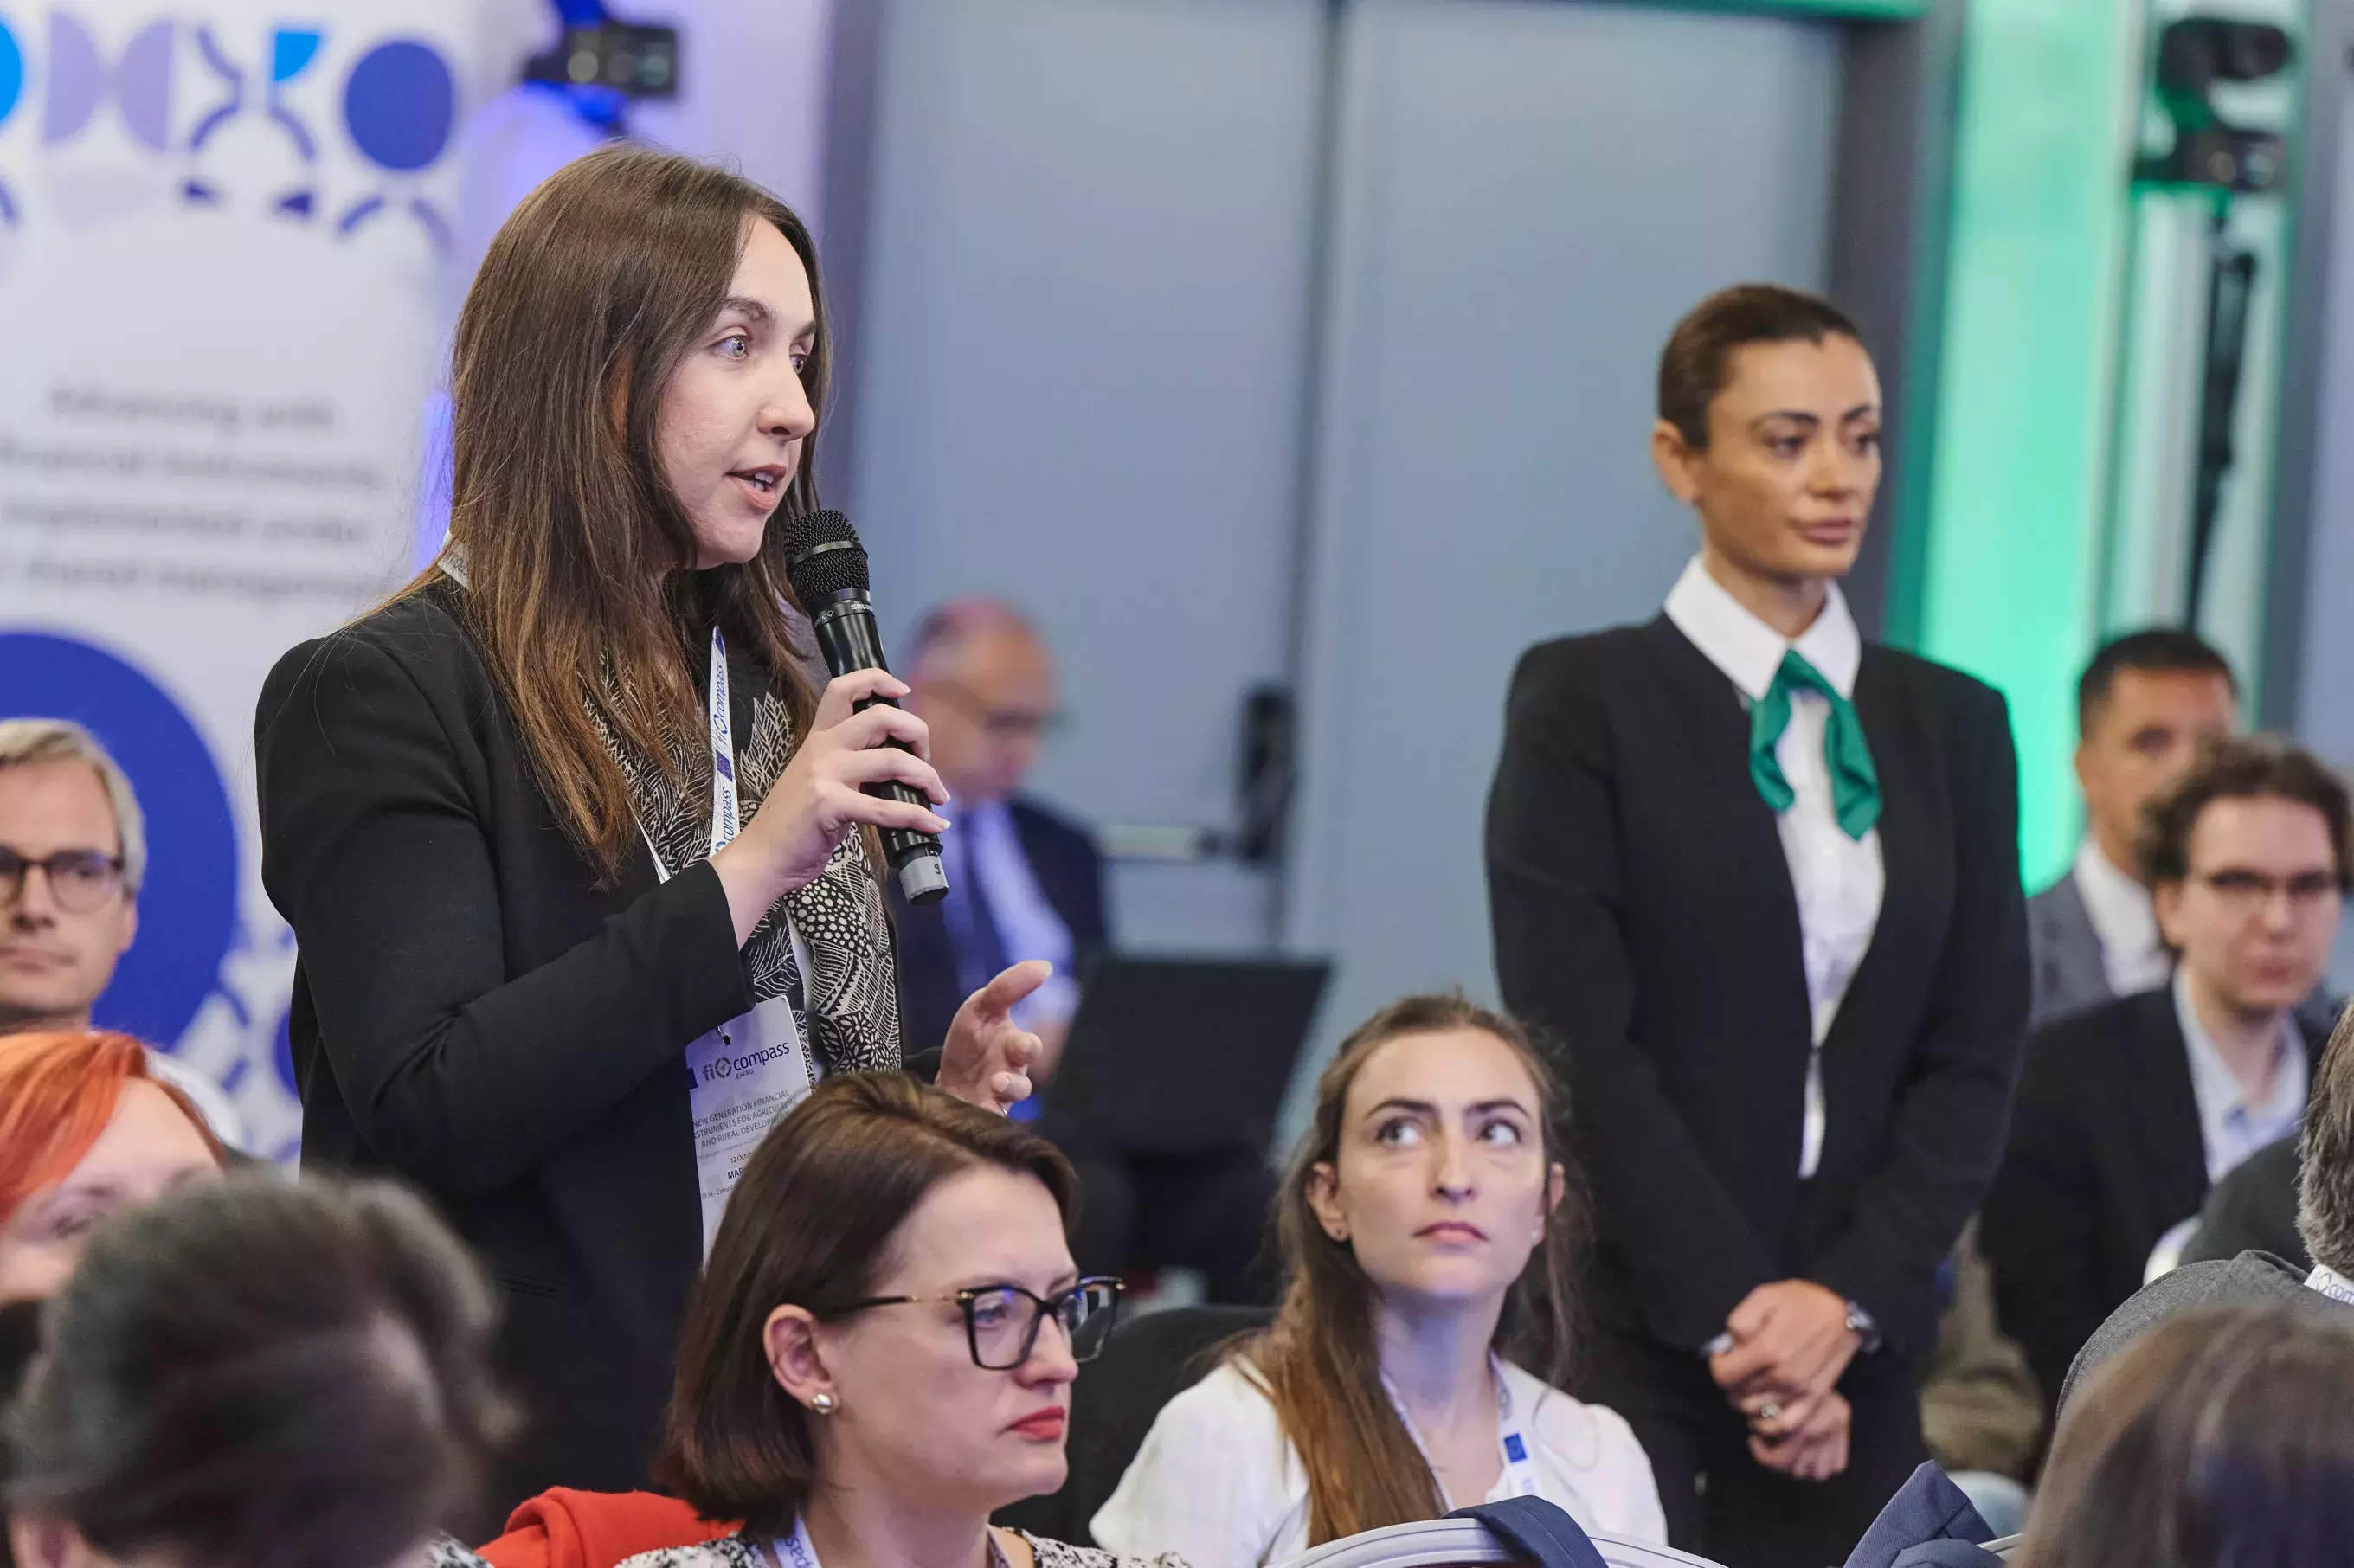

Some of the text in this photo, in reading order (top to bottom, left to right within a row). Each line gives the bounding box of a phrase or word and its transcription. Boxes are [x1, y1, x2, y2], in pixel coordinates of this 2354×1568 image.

[850, 603, 873, 612] SHURE
[717, 660, 726, 718] compass
[722, 786, 736, 841] compass
[733, 1042, 790, 1070] compass
[736, 1069, 754, 1079] EAFRD
[692, 1089, 789, 1128] NEW GENERATION FINANCIAL
[737, 1113, 752, 1125] FOR
[702, 1136, 717, 1148] AND
[717, 1129, 740, 1142] RURAL
[737, 1151, 752, 1161] Octob
